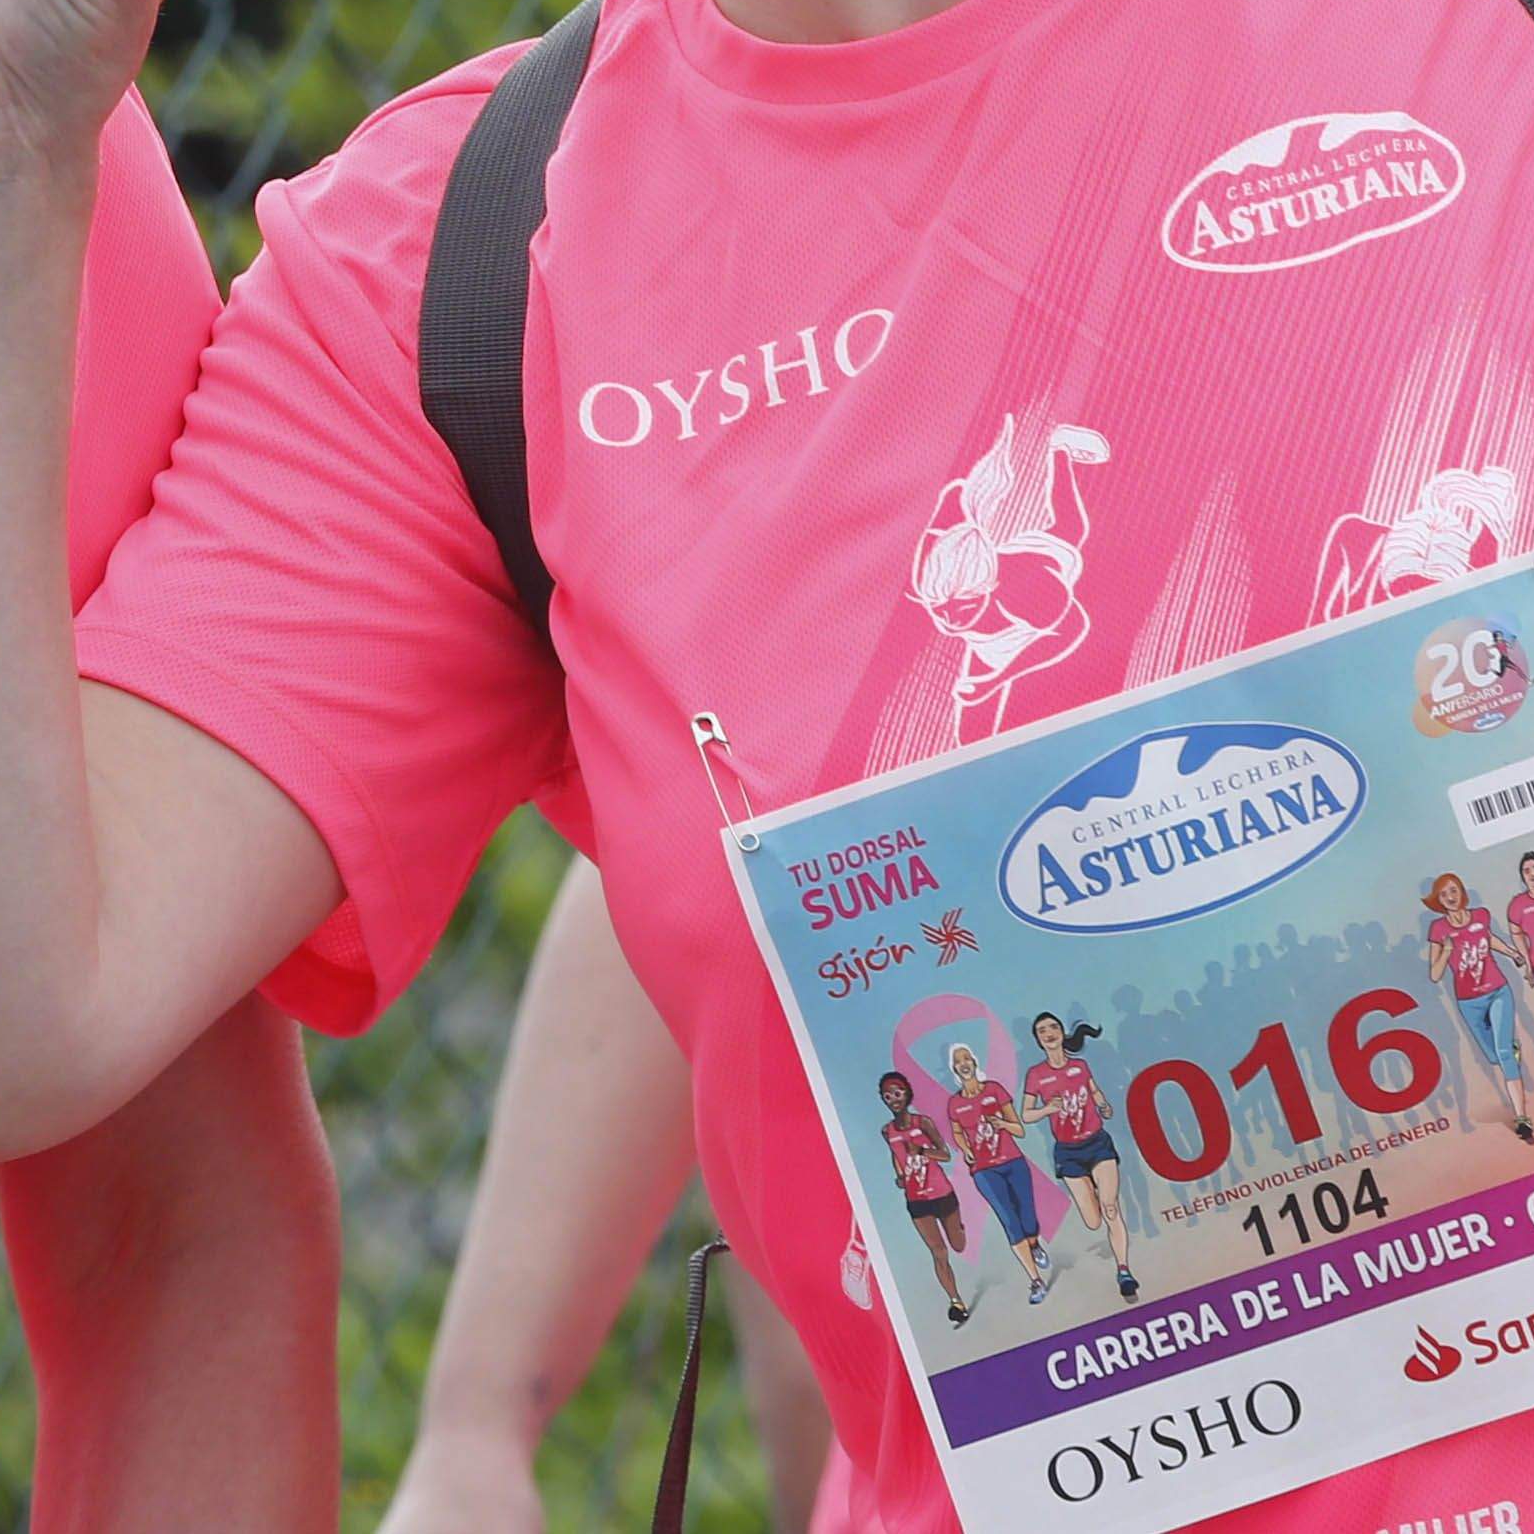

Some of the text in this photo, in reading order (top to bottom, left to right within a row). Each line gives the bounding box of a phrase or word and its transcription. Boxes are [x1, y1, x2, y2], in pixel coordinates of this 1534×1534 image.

[1188, 158, 1447, 256] ASTURIANA
[1226, 137, 1428, 201] CENTRAL LECHERA
[578, 307, 895, 447] OYSHO
[1036, 773, 1348, 916] ASTURIANA
[1071, 749, 1317, 845] CENTRAL LECHERA
[787, 825, 927, 888] TU DORSAL
[801, 853, 941, 931] SUMA
[818, 935, 916, 999] gijón
[1125, 987, 1443, 1183] 016
[1160, 1116, 1451, 1224] TELÉFONO VIOLENCIA DE GÉNERO
[1242, 1167, 1390, 1257] 1104
[1046, 1302, 1229, 1391] CARRERA
[1231, 1280, 1289, 1330] DE
[1291, 1262, 1351, 1310] LA
[1352, 1212, 1496, 1289] MUJER
[1046, 1378, 1303, 1503] OYSHO
